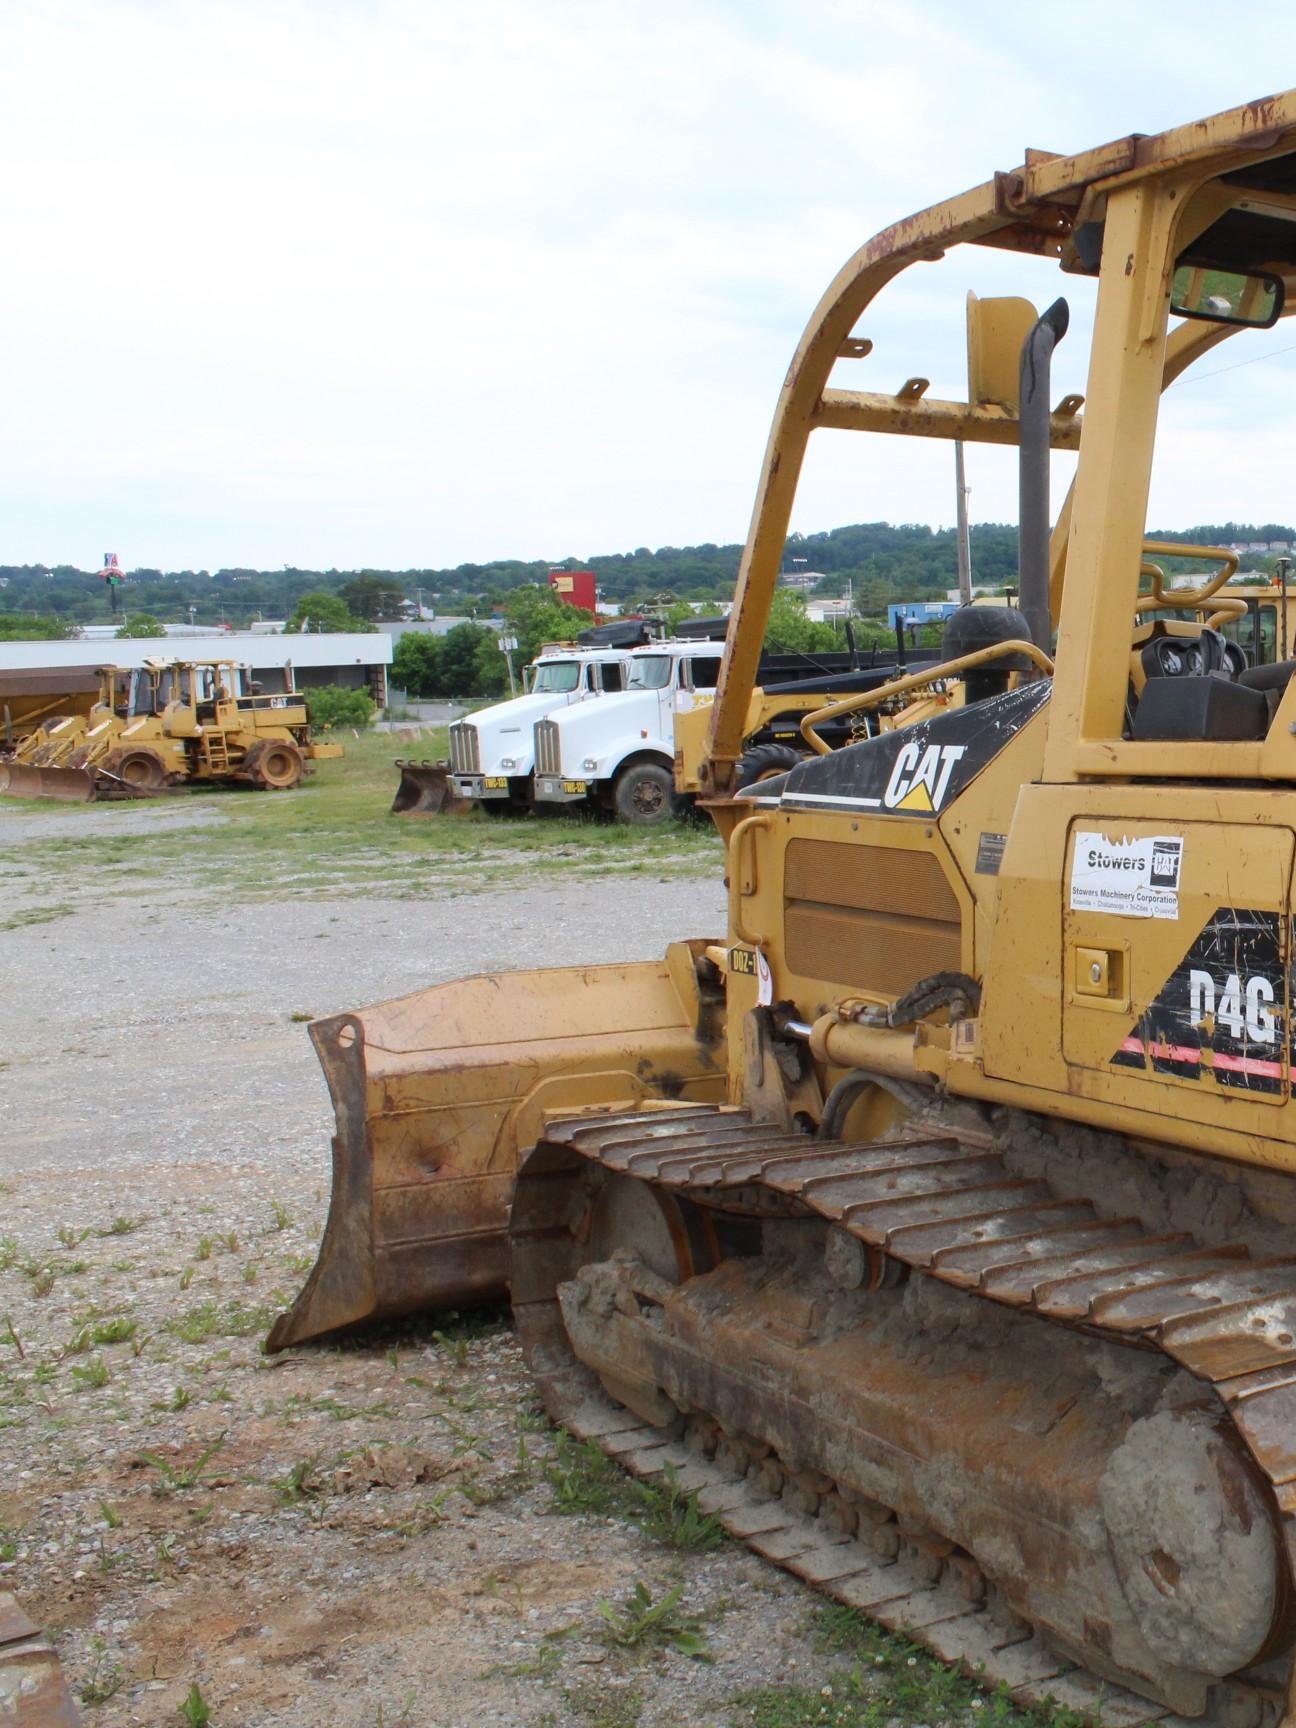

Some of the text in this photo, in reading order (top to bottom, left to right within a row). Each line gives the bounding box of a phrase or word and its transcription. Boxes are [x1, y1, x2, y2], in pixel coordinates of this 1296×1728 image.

[270, 697, 288, 708] CAT
[884, 742, 965, 812] CAT
[1088, 850, 1146, 871] Stowers
[1072, 886, 1177, 904] Stowers Machinery Corporation
[1190, 969, 1275, 1044] D4G
